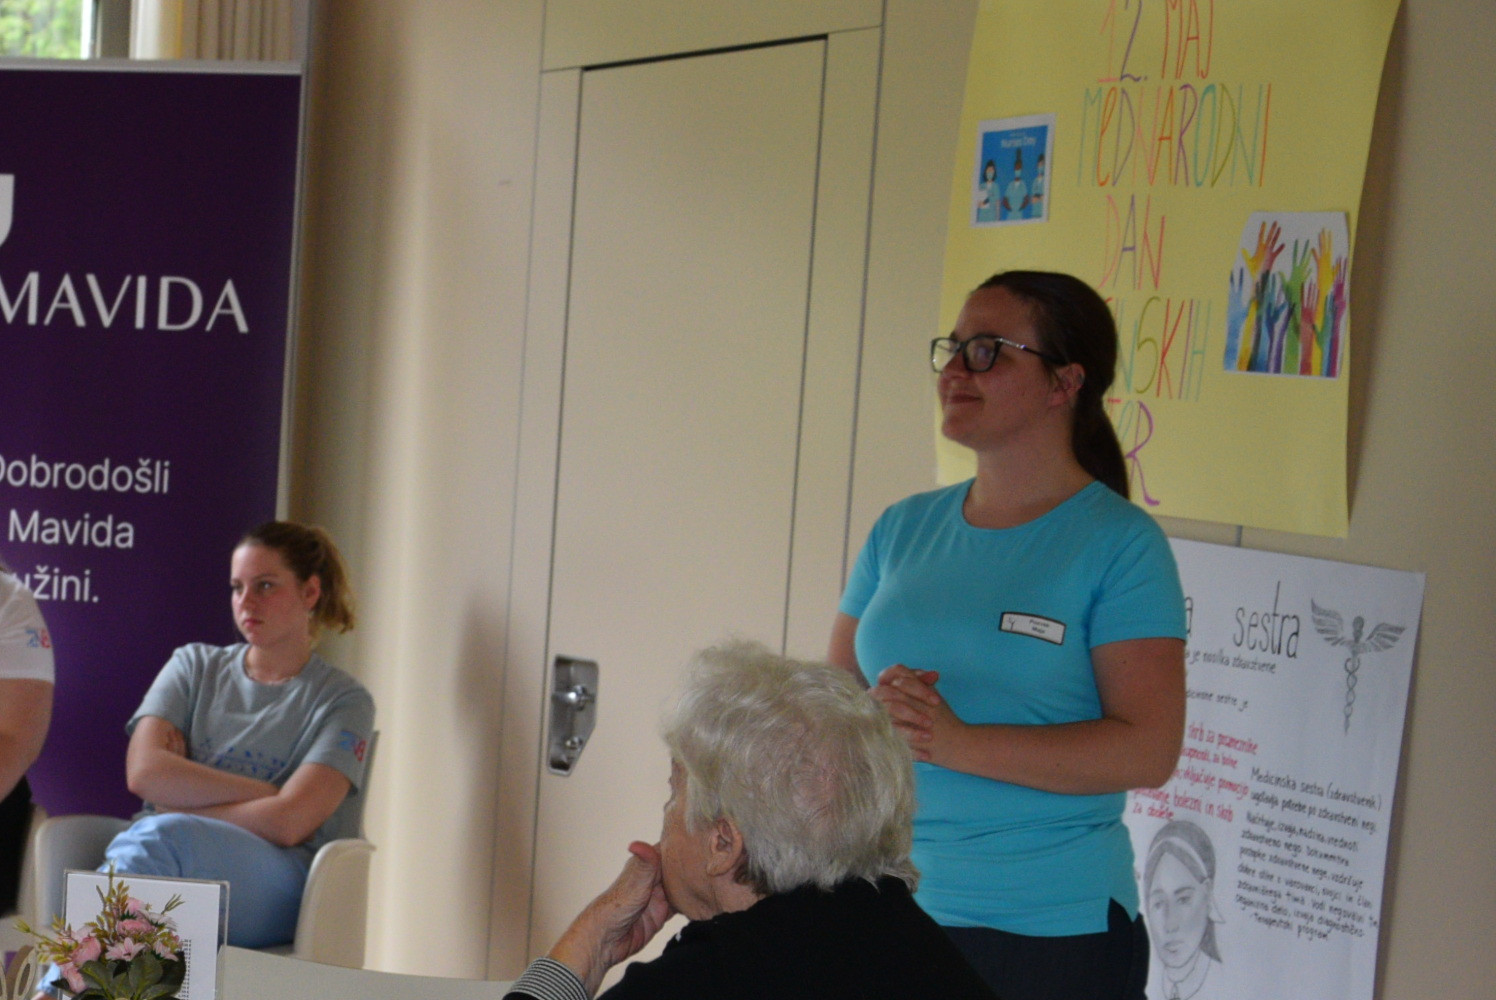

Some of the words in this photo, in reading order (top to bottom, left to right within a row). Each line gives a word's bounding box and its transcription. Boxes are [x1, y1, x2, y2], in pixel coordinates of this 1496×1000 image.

[1160, 0, 1214, 79] MAJ
[1098, 194, 1166, 291] DAN
[8, 508, 135, 549] Mavida
[22, 564, 100, 604] žini.
[1232, 580, 1301, 660] sestra
